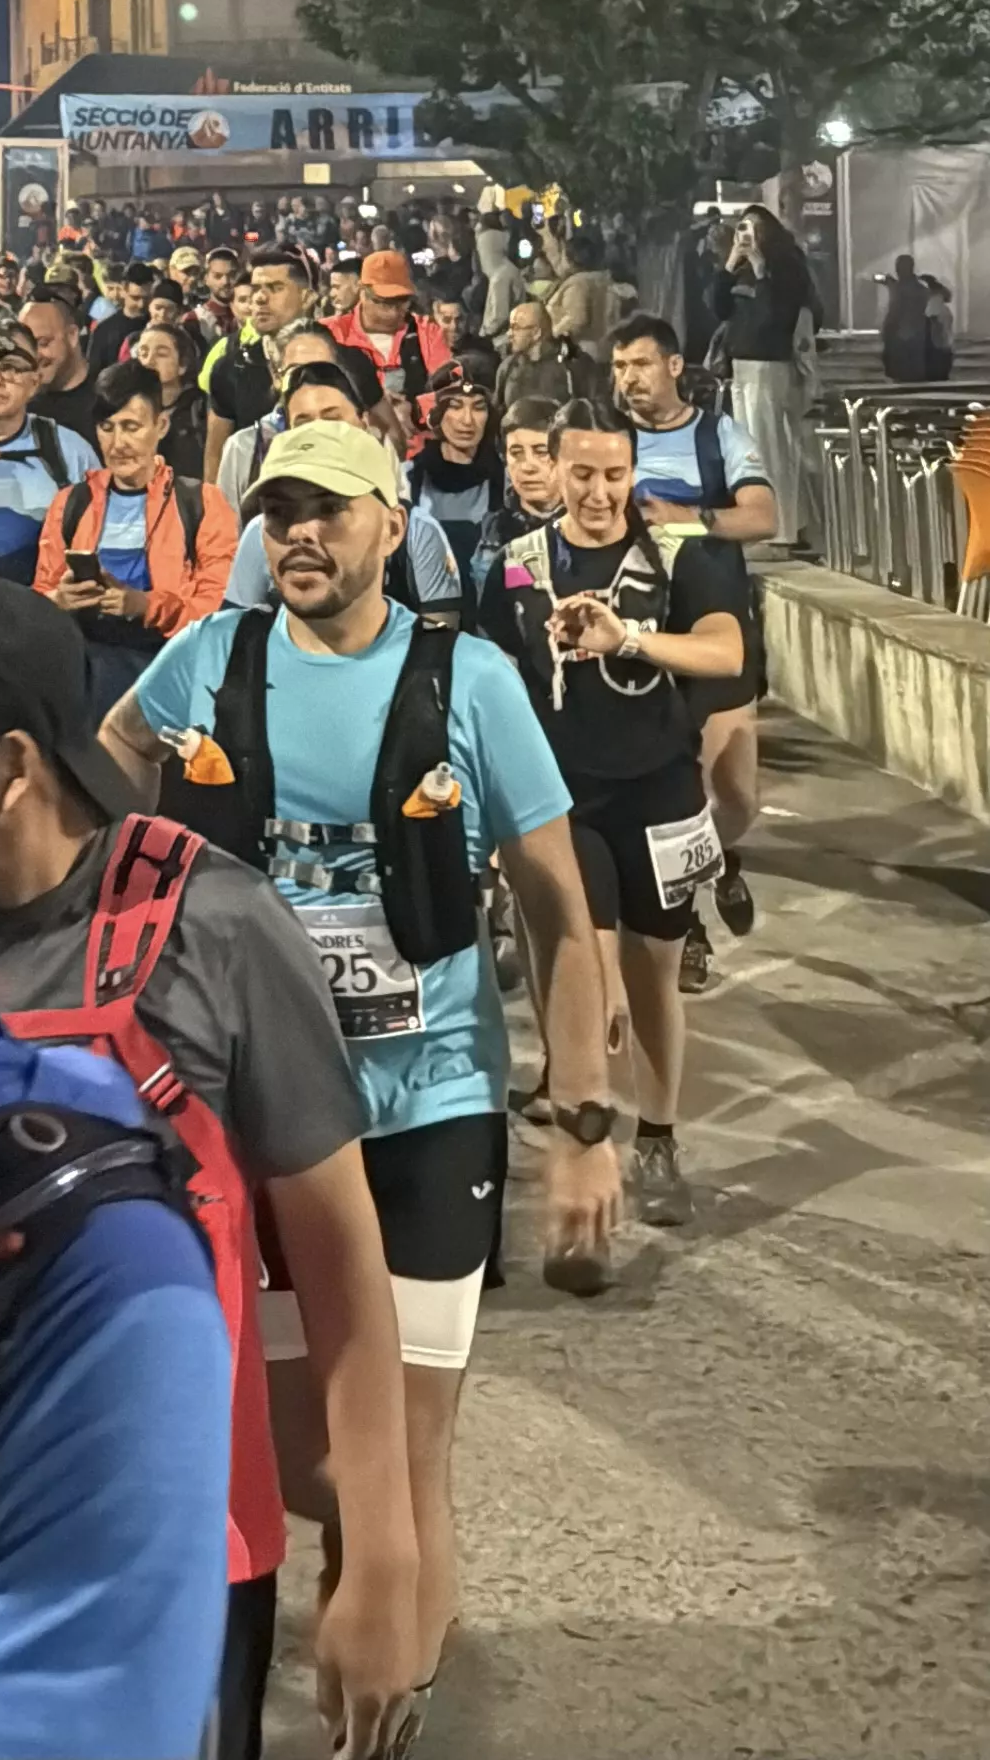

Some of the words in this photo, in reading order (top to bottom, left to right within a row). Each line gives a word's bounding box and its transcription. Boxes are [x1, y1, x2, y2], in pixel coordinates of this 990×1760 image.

[233, 81, 291, 94] Federació
[73, 104, 157, 128] SECCIÓ
[270, 106, 430, 150] ARRI
[680, 836, 714, 874] 285
[309, 934, 365, 949] NDRES
[320, 953, 378, 993] 25
